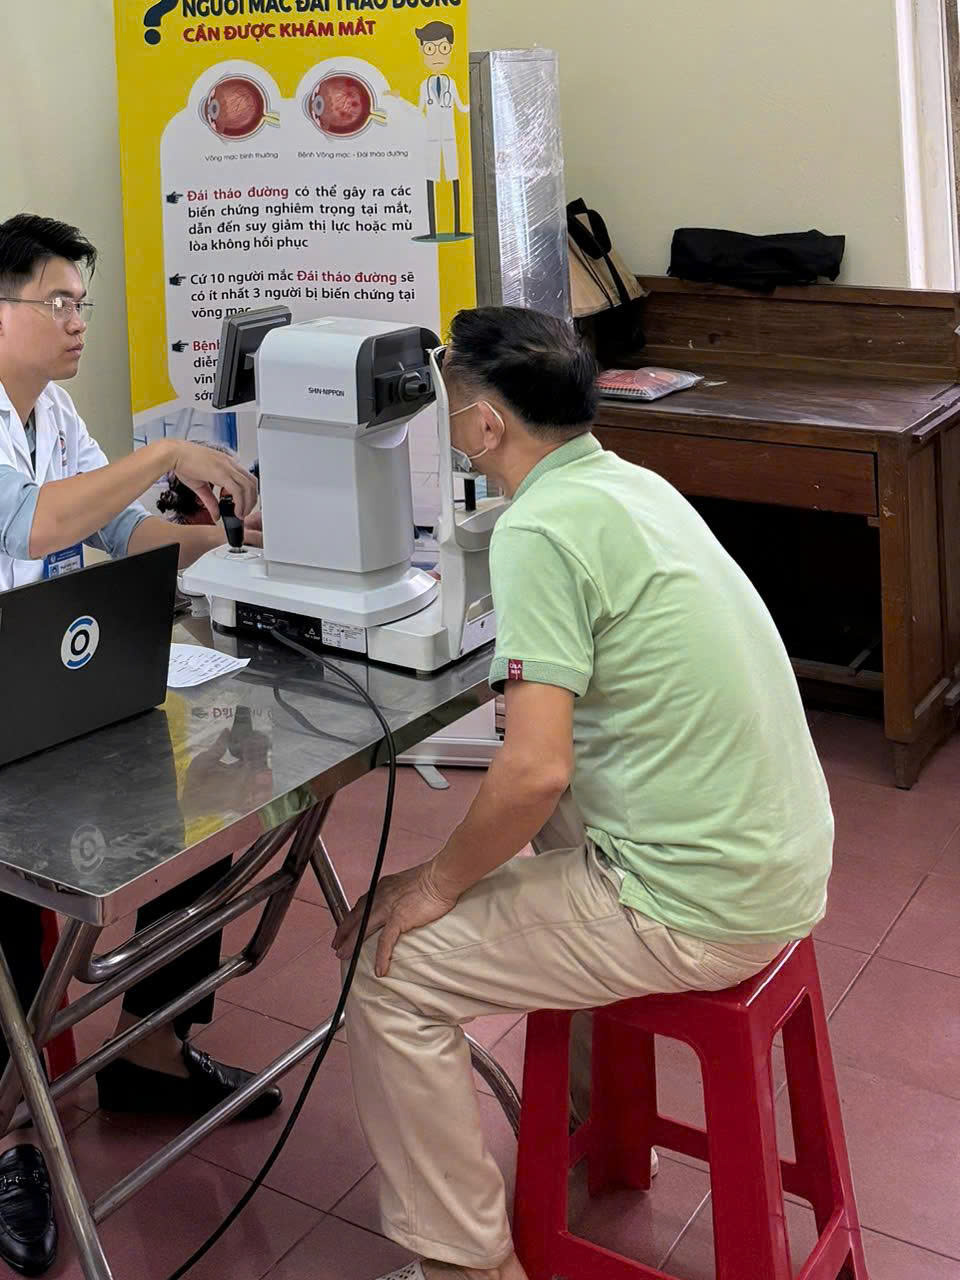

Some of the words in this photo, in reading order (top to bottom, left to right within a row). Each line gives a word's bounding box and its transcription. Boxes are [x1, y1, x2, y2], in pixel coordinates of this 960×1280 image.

[183, 23, 220, 42] CẦN
[223, 22, 276, 42] ĐƯỢC
[279, 20, 334, 37] KHÁM
[338, 16, 376, 36] MẮT
[187, 189, 208, 201] Đái
[213, 188, 242, 200] tháo
[247, 186, 289, 200] đường
[295, 185, 310, 197] có
[316, 184, 337, 197] thể
[343, 186, 366, 200] gây
[372, 188, 385, 197] ra
[390, 185, 412, 197] các
[188, 205, 215, 218] biến
[220, 203, 259, 217] chứng
[265, 202, 314, 216] nghiêm
[320, 204, 355, 217] trọng
[361, 203, 378, 217] tại
[384, 200, 412, 215] mắt,
[189, 222, 212, 235] dẫn
[217, 220, 240, 233] đến
[245, 222, 267, 233] suy
[272, 219, 304, 233] giảm
[309, 220, 326, 234] thị
[331, 220, 351, 234] lực
[355, 220, 387, 234] hoặc
[392, 219, 412, 231] mù
[189, 240, 208, 252] lòa
[211, 238, 251, 251] không
[253, 235, 273, 248] hồi
[277, 236, 309, 250] phục
[190, 273, 208, 285] Cứ
[210, 273, 225, 284] 10
[228, 270, 264, 285] người
[268, 268, 294, 281] mắc
[296, 270, 318, 281] Đái
[322, 271, 351, 283] tháo
[355, 271, 397, 286] đường
[401, 271, 415, 283] sẽ
[191, 290, 206, 302] có
[209, 289, 218, 301] ít
[221, 286, 250, 300] nhất
[253, 287, 261, 298] 3
[265, 286, 302, 301] người
[306, 287, 318, 301] bị
[322, 286, 350, 299] biến
[354, 288, 395, 303] chứng
[399, 288, 415, 302] tại
[192, 307, 223, 320] võng
[308, 387, 344, 397] SHIN-NIPPON
